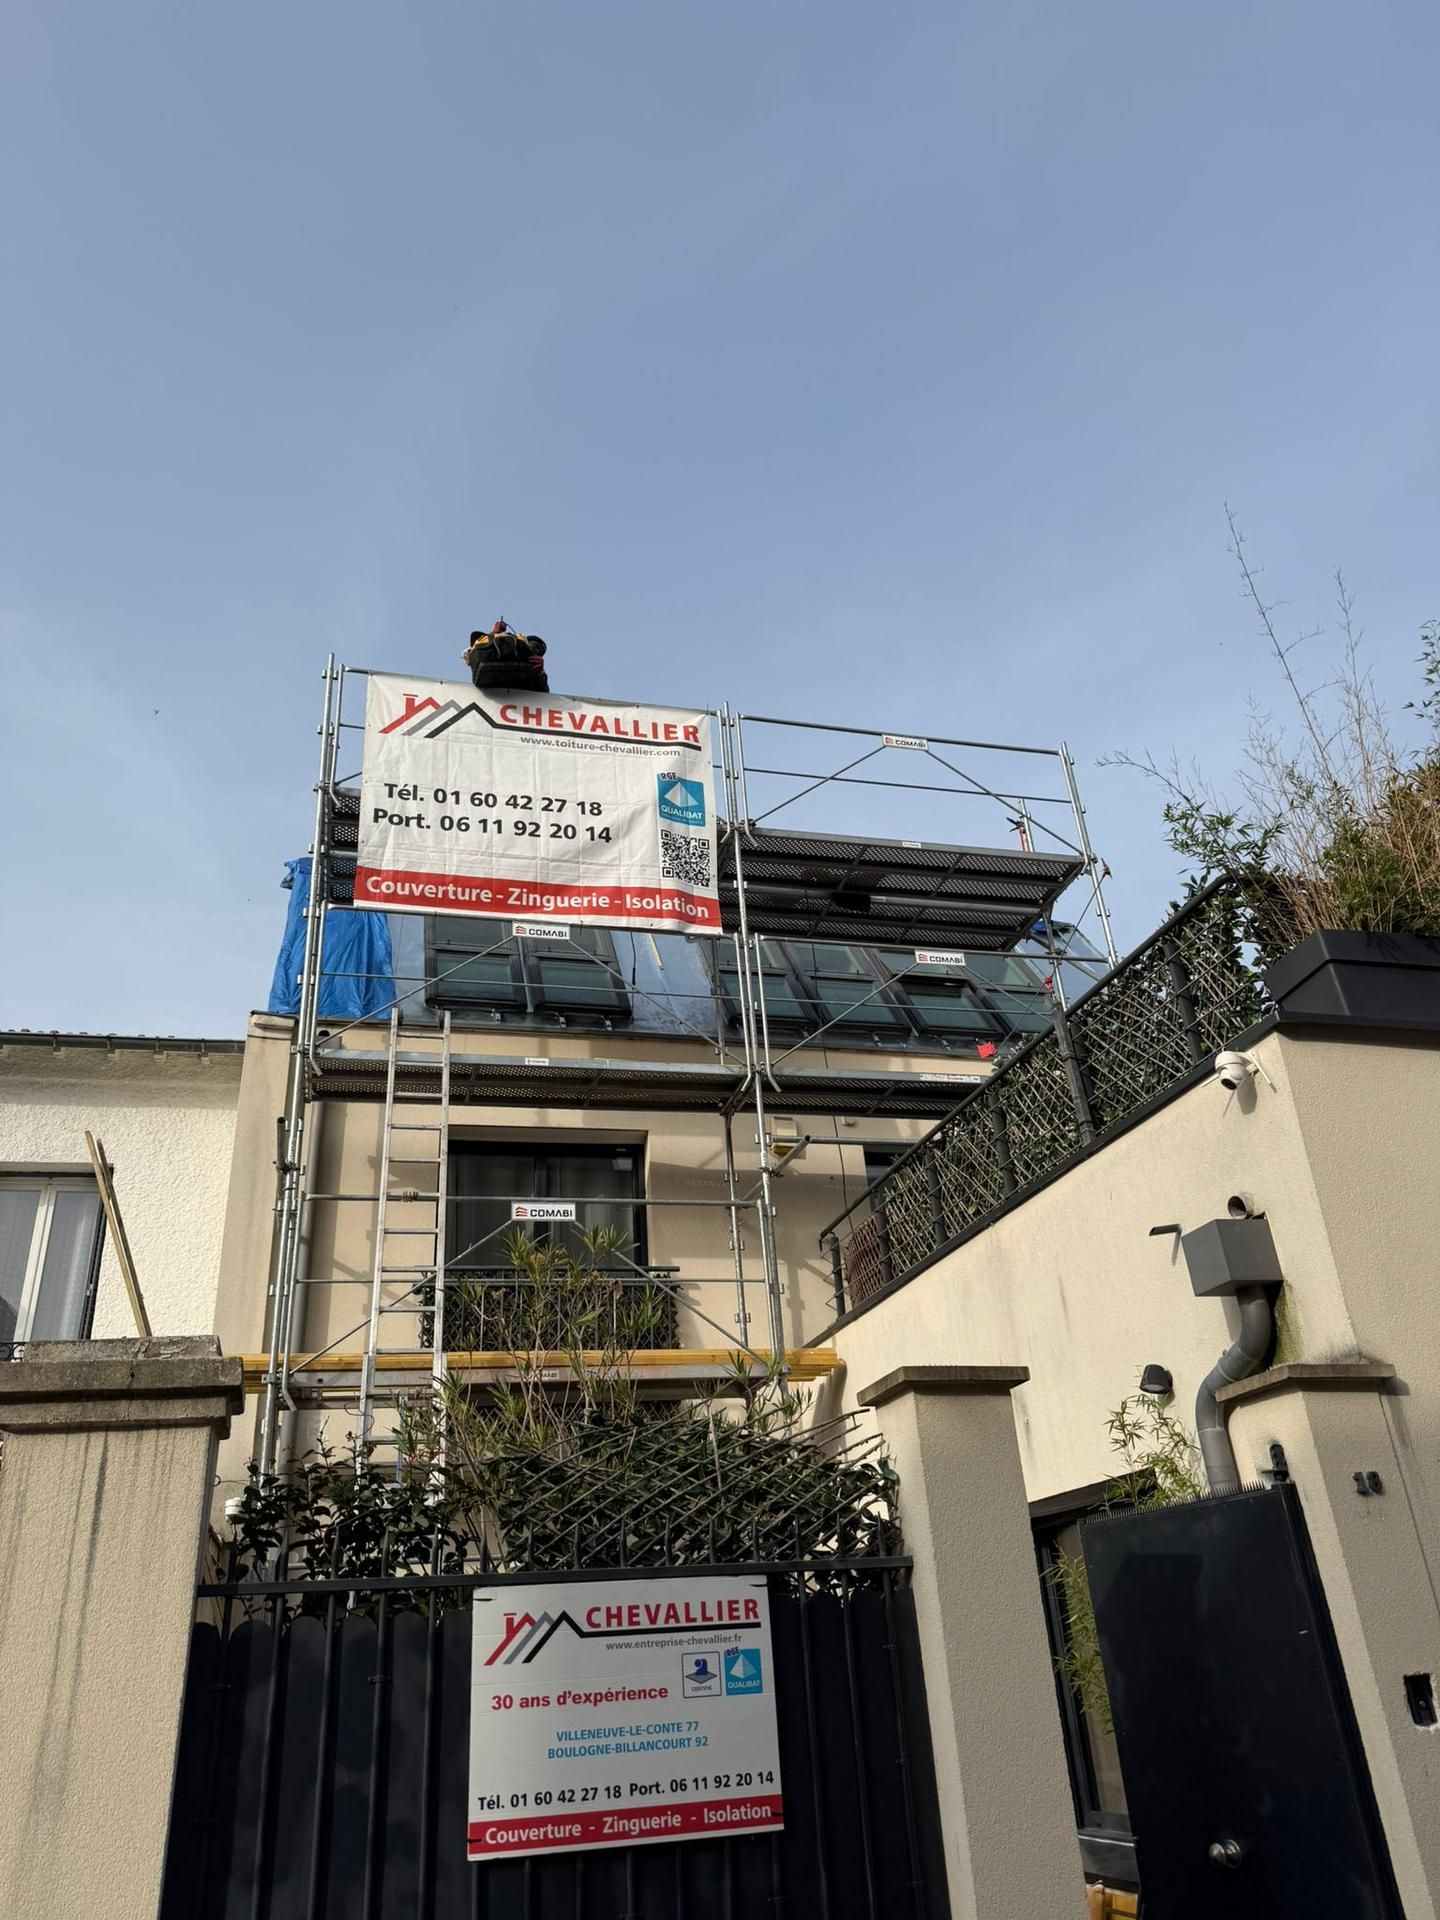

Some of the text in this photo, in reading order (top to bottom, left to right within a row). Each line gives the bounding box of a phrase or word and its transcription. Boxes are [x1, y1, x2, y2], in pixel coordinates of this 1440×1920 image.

[500, 704, 700, 743] CHEVALLIER
[520, 736, 682, 757] www.toiture-chevallier.com
[895, 739, 927, 748] COMABI
[660, 771, 678, 780] RGE
[384, 783, 602, 816] Tél. 01 60 42 27 18
[660, 804, 703, 820] QUALIBAT
[373, 808, 612, 843] Port. 06 11 92 20 14
[366, 876, 493, 903] Couverture
[507, 887, 610, 911] Zinguerie
[625, 894, 709, 918] Isolation
[528, 928, 568, 938] COMABI
[929, 955, 964, 964] COMABI
[530, 1209, 573, 1218] COMABI
[585, 1598, 760, 1629] CHEVALLIER
[605, 1633, 742, 1651] www.entreprise-chevallier.fr
[728, 1680, 761, 1689] QUALIBAT
[491, 1694, 514, 1711] 30
[519, 1694, 551, 1709] ans
[556, 1721, 700, 1742] VILLENEUVE-LE-CONTE 77
[547, 1736, 709, 1759] BOULOGNE-BILLANCOURT 92
[478, 1771, 775, 1810] Tél. 01 60 42 27 18 Port. 06 11 92 20 14
[485, 1823, 582, 1844] Couverture
[602, 1811, 682, 1835] Zinguerie
[703, 1803, 772, 1824] Isolation
